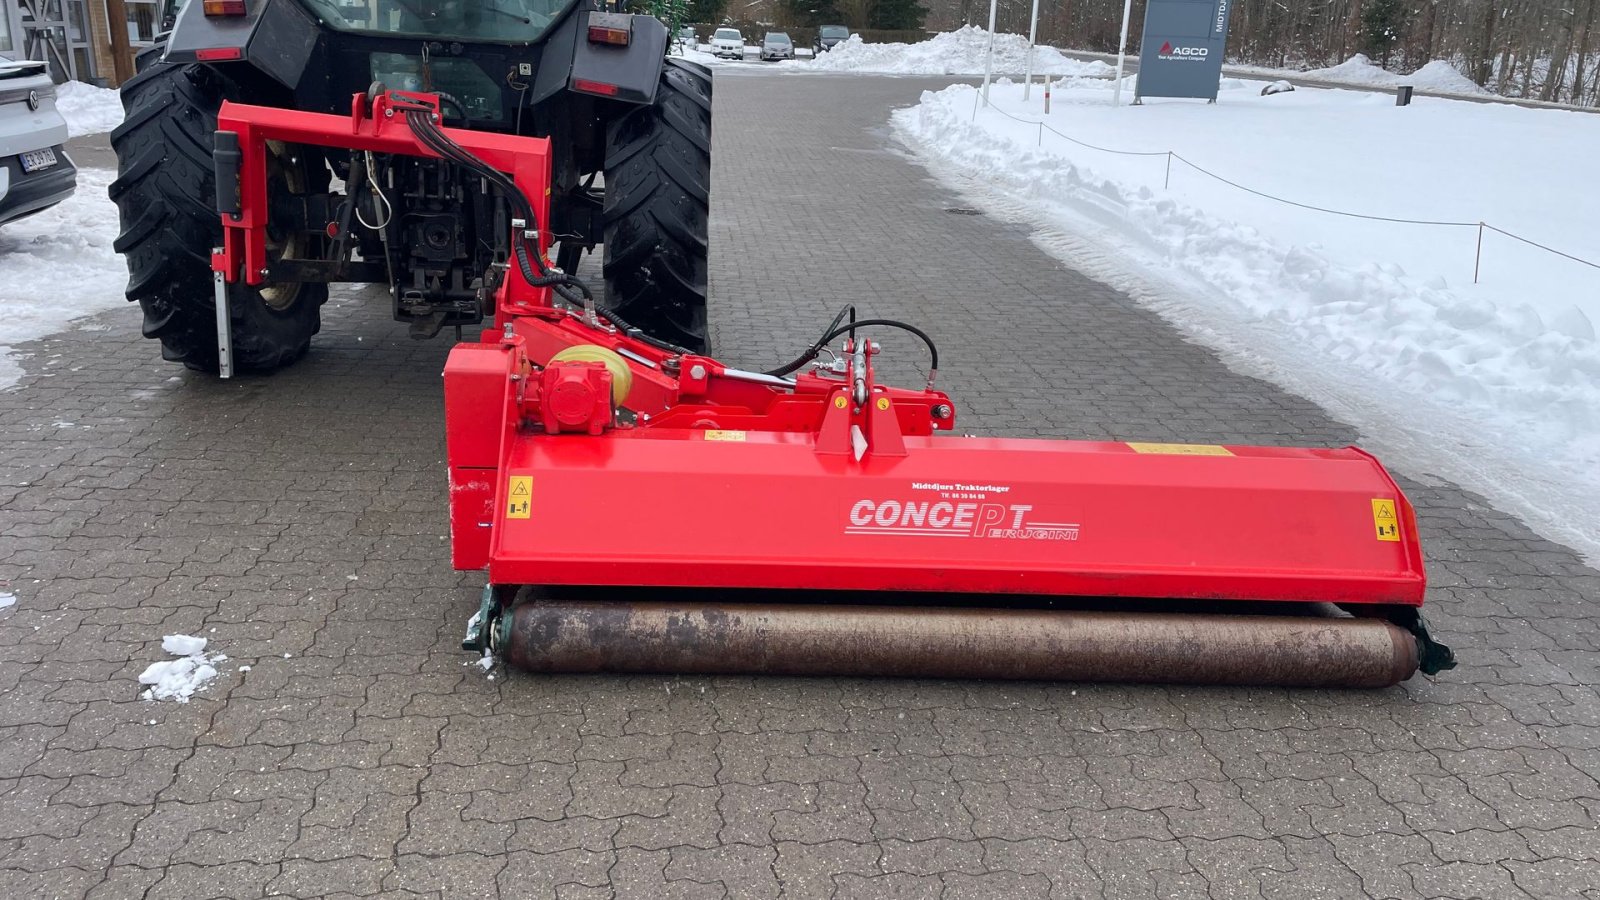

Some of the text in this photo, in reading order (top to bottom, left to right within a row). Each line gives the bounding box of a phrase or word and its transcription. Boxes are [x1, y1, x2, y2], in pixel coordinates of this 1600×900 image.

[1215, 0, 1227, 32] MIDTDJ
[1172, 46, 1208, 56] AGCO
[911, 482, 1010, 493] Midtdjurs Traktorlager
[849, 499, 1033, 538] CONCEPT
